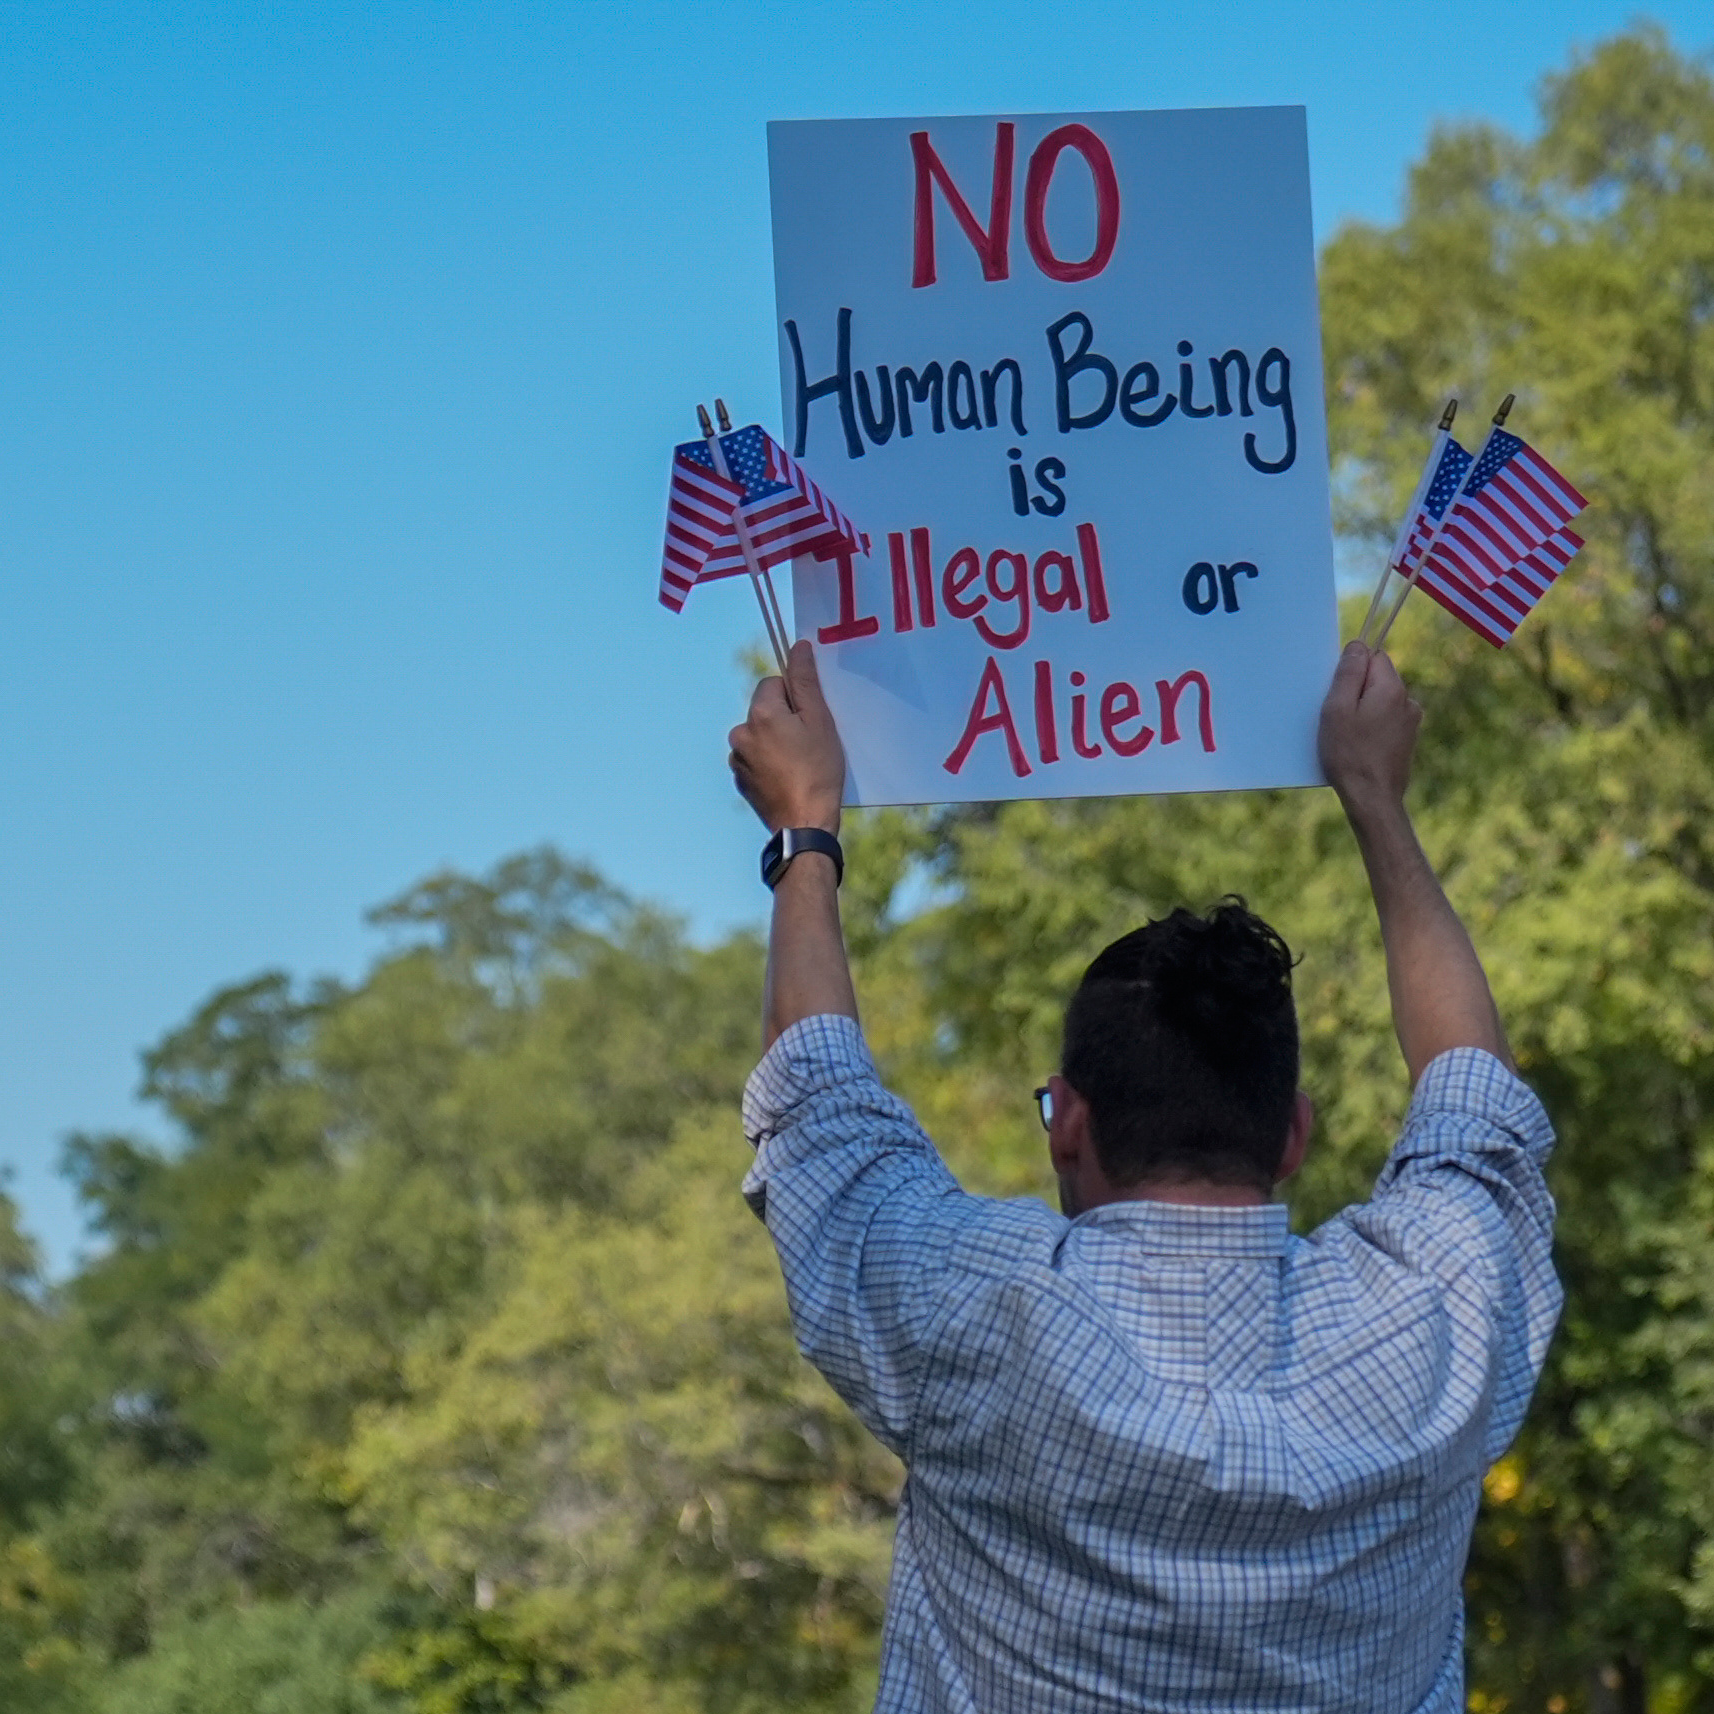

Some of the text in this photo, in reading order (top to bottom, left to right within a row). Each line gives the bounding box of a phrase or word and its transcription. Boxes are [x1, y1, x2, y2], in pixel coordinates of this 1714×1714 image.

[910, 122, 1119, 289] NO
[784, 307, 1297, 474] Human Being
[1007, 447, 1066, 517] is
[812, 523, 1260, 650] Illegal or
[943, 656, 1217, 778] Alien
